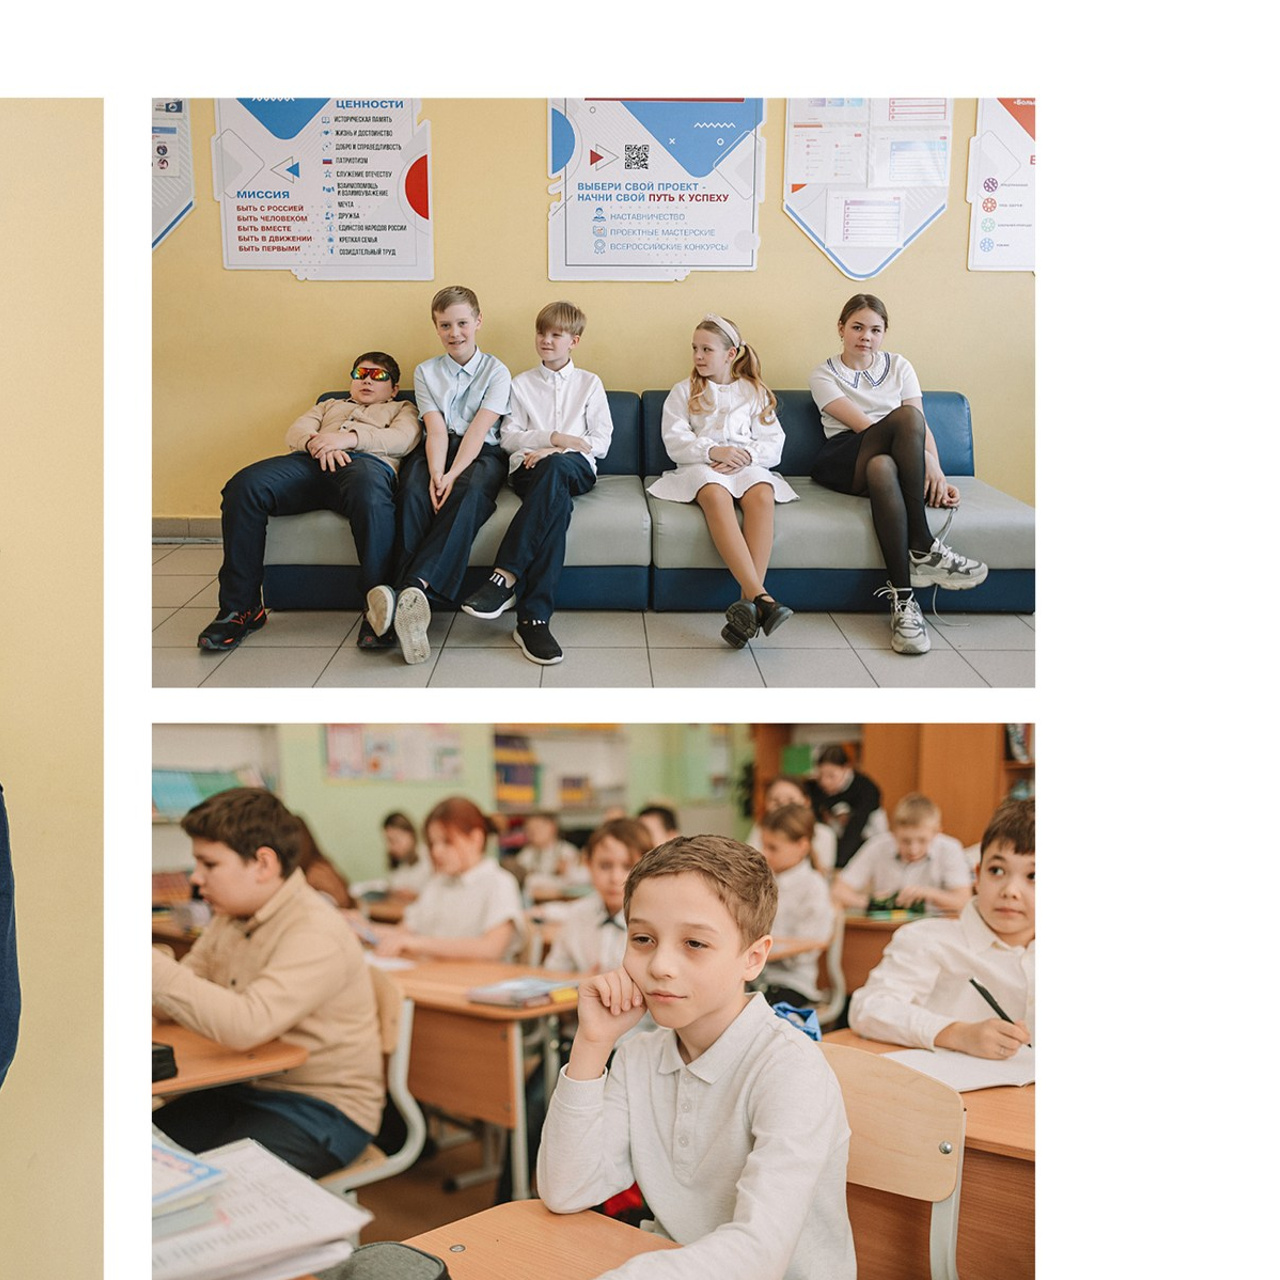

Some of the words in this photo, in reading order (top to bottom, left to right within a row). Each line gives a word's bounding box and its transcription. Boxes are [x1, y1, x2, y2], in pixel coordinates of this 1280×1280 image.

[336, 100, 404, 109] ЦЕННОСТИ
[577, 182, 622, 191] ВЫБЕРИ
[625, 181, 654, 191] СВОЙ
[658, 182, 699, 191] ПРОЕКТ
[236, 190, 290, 199] МИССИЯ
[577, 193, 613, 202] НАЧНИ
[616, 192, 645, 202] СВОЙ
[649, 193, 675, 202] ПУТЬ
[678, 193, 685, 202] К
[688, 193, 730, 202] УСПЕХУ
[267, 204, 304, 212] РОССИЕЙ
[610, 213, 685, 221] НАСТАВНИЧЕСТВО
[610, 228, 658, 237] ПРОЕКТНЫЕ
[661, 228, 716, 237] МАСТЕРСКИЕ
[268, 235, 313, 243] ДВИЖЕНИИ
[610, 242, 682, 251] ВСЕРОССИЙСКИЕ
[684, 242, 729, 251] КОНКУРСЫ
